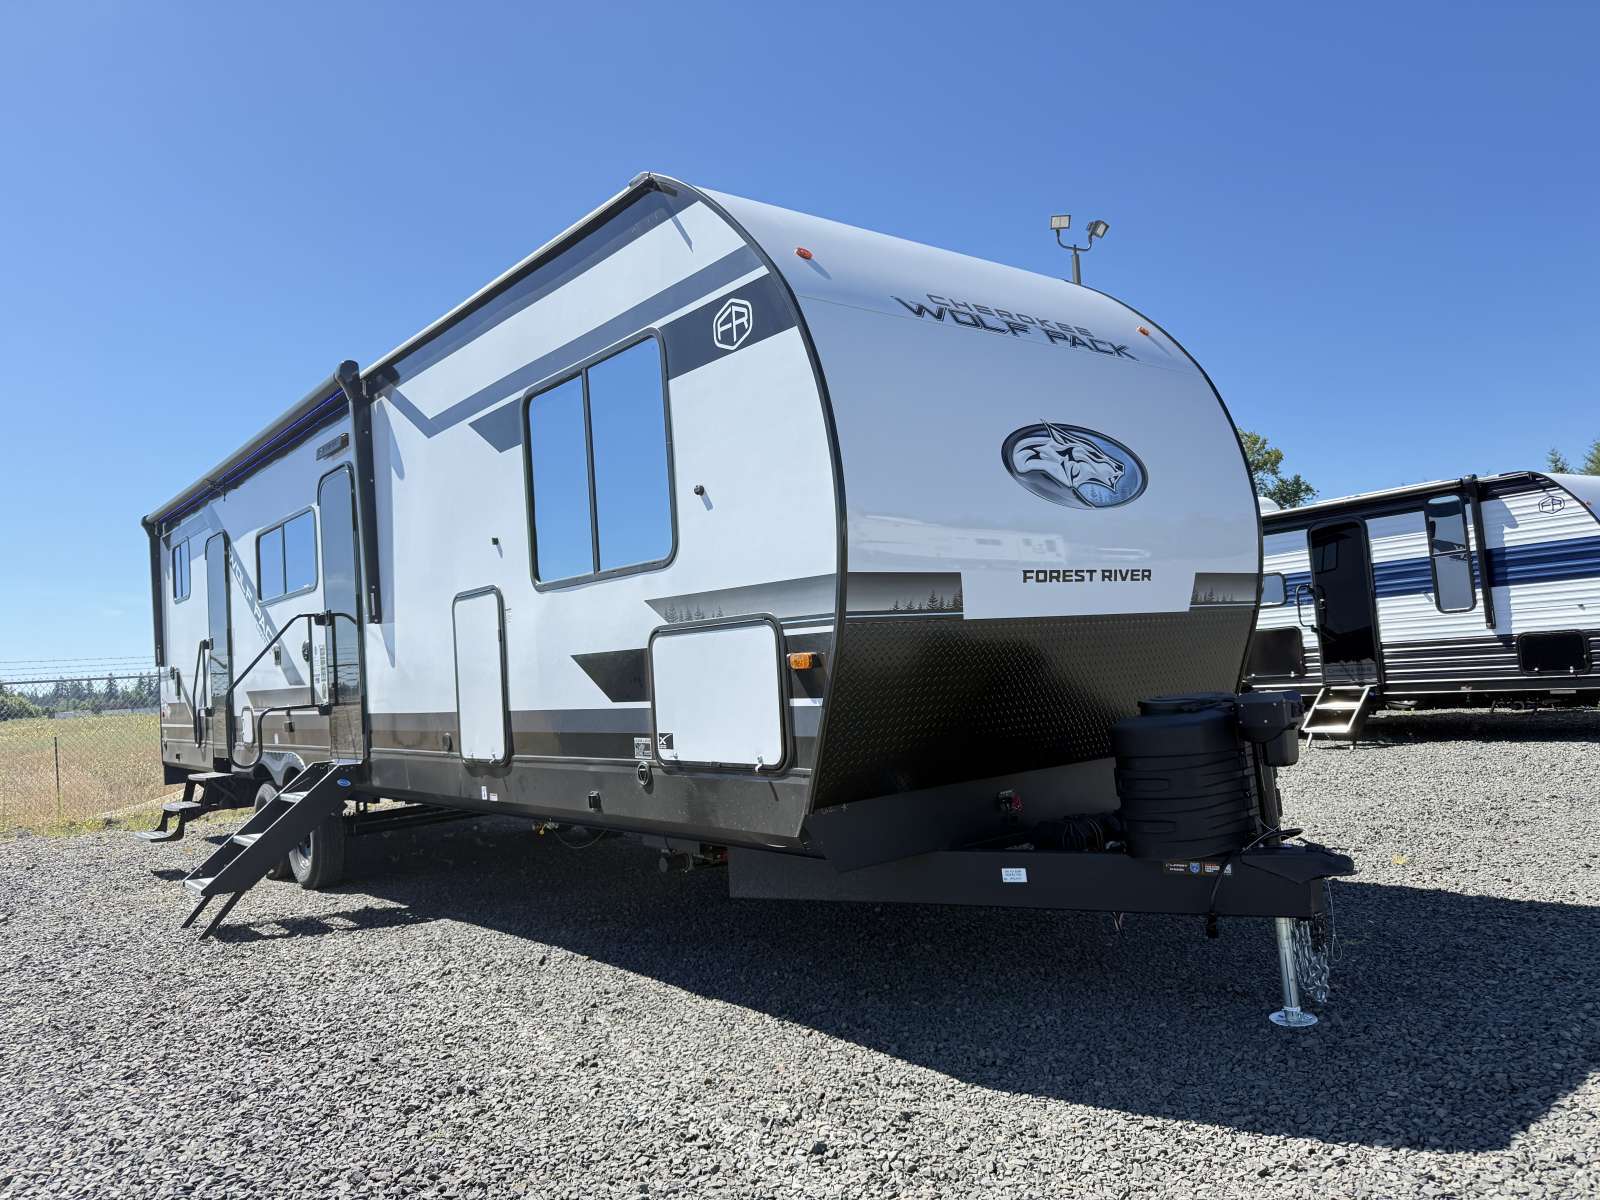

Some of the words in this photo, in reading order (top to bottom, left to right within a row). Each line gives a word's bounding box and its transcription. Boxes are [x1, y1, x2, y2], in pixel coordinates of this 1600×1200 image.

[890, 295, 1031, 337] WOLF
[1040, 327, 1140, 361] PACK
[926, 293, 1094, 337] CHEROKEE
[1022, 569, 1097, 584] FOREST
[1101, 569, 1152, 582] RIVER
